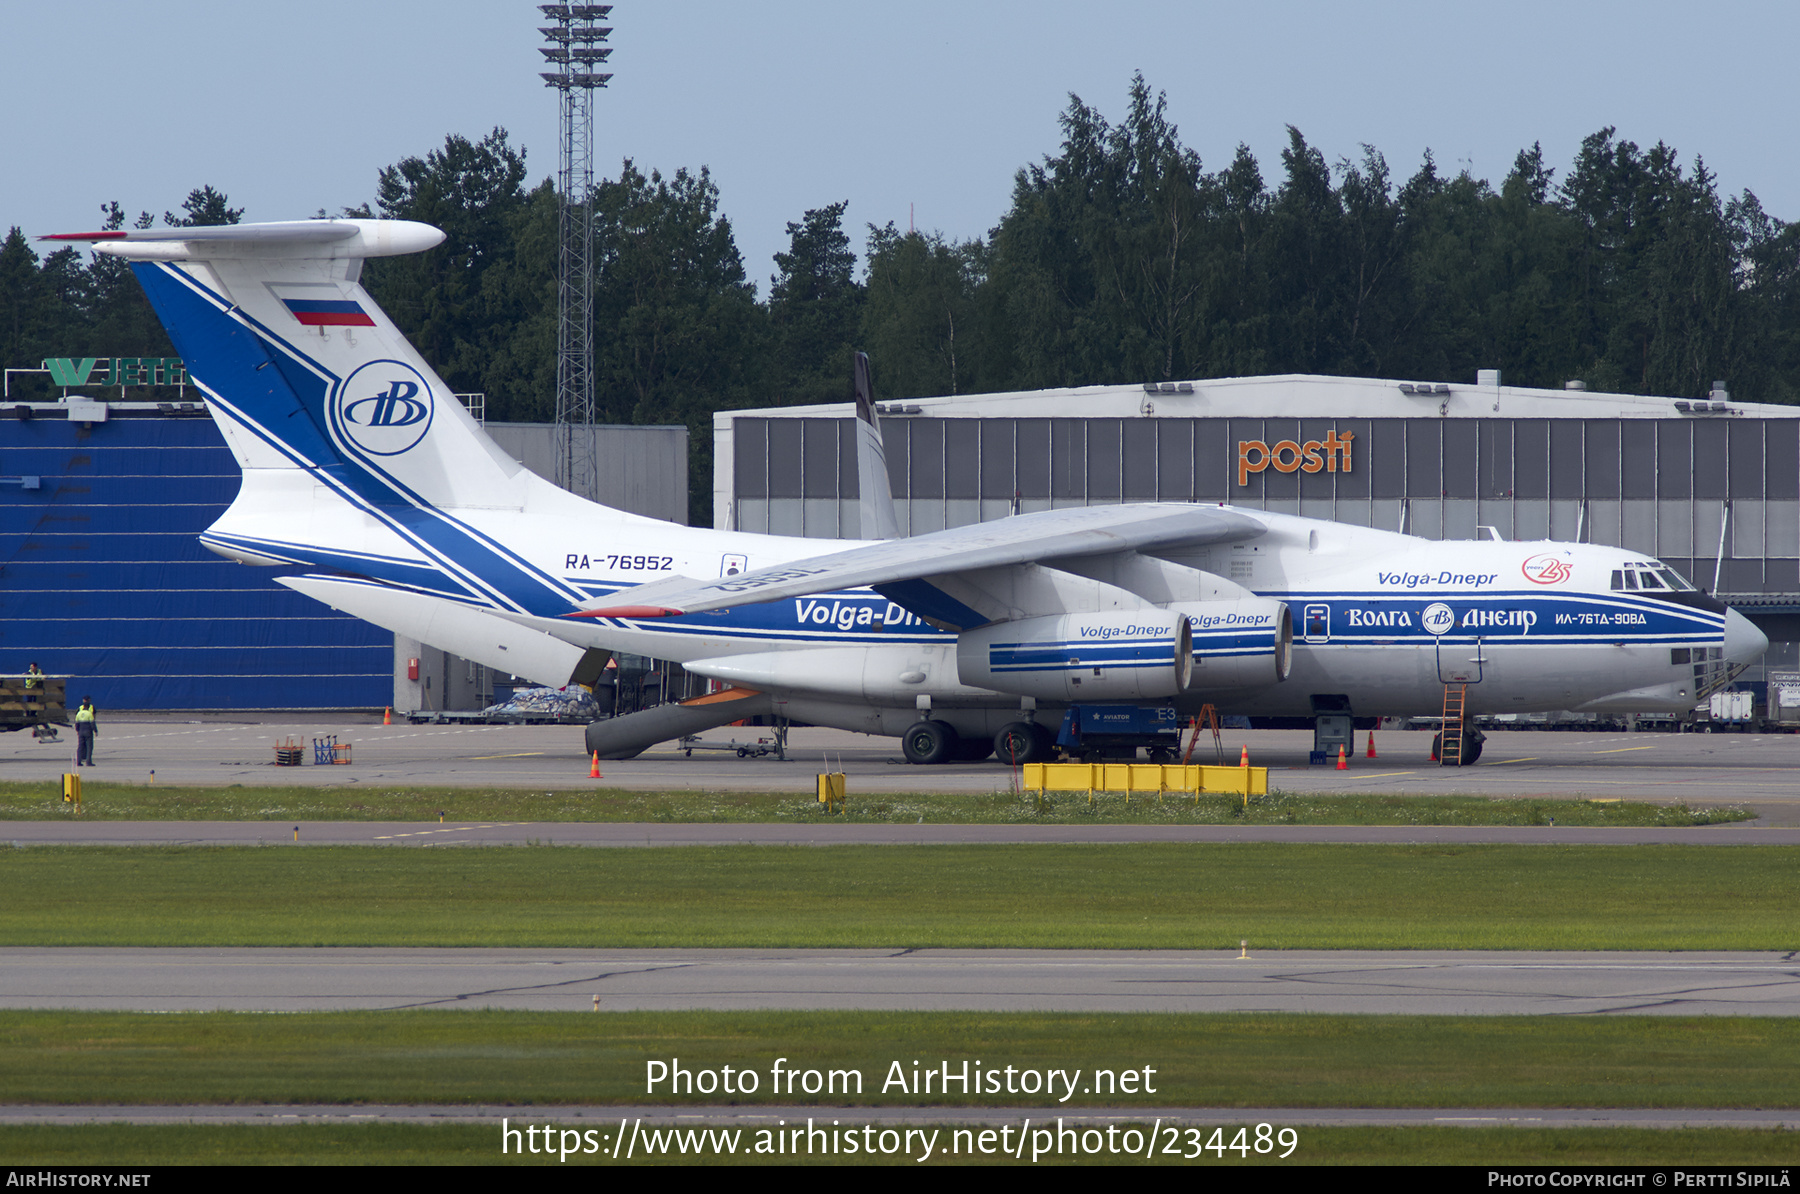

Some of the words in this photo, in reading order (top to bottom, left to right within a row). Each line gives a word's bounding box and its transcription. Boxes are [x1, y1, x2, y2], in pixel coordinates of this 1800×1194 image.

[1239, 430, 1354, 486] posti
[566, 554, 673, 571] RA-76952
[1538, 558, 1573, 584] 25
[1379, 571, 1498, 588] Volga-Dnepr
[1080, 624, 1171, 639] Volga-Dnepr
[1158, 707, 1176, 720] E3
